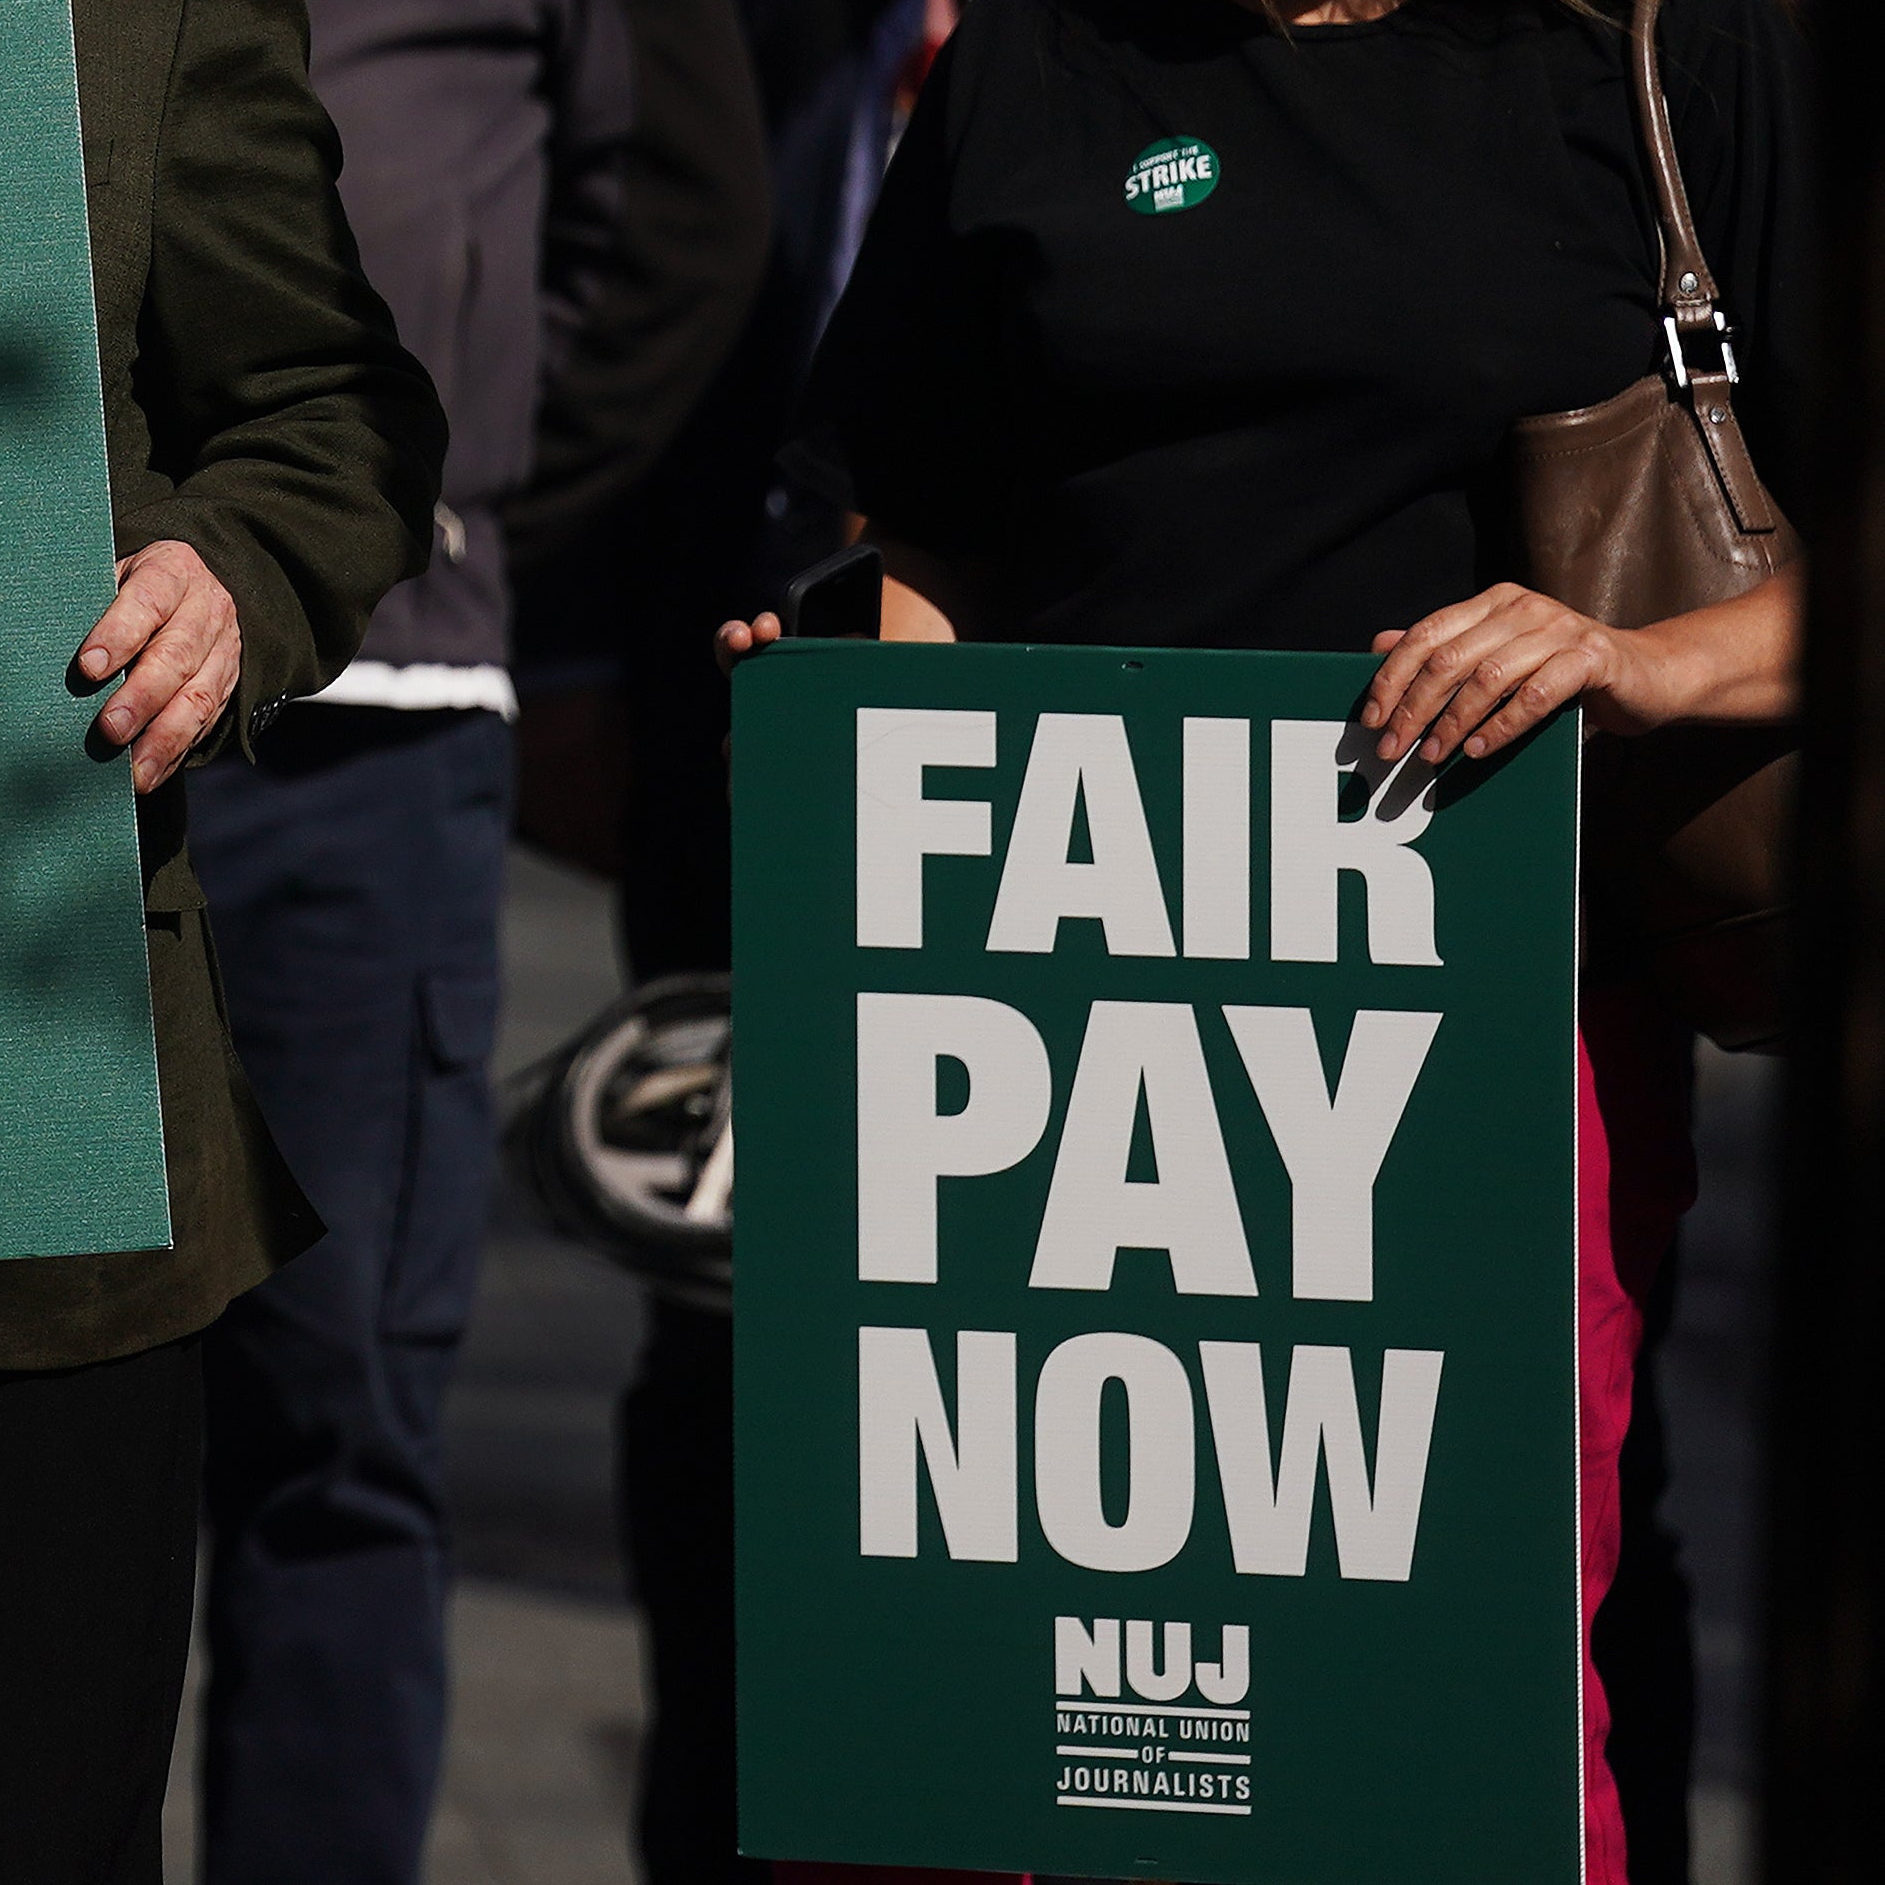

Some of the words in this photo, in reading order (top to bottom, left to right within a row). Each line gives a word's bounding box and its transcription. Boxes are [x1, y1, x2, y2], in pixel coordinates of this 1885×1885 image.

[1125, 154, 1212, 200] STRIKE
[856, 707, 1445, 967] FAIR
[857, 991, 1444, 1302] PAY
[858, 1325, 1445, 1582] NOW
[1054, 1616, 1251, 1705] NUJ
[1056, 1713, 1169, 1738] NATIONAL
[1179, 1719, 1250, 1743] UNION
[1141, 1745, 1166, 1764] OF
[1056, 1767, 1251, 1800] JOURNALISTS
